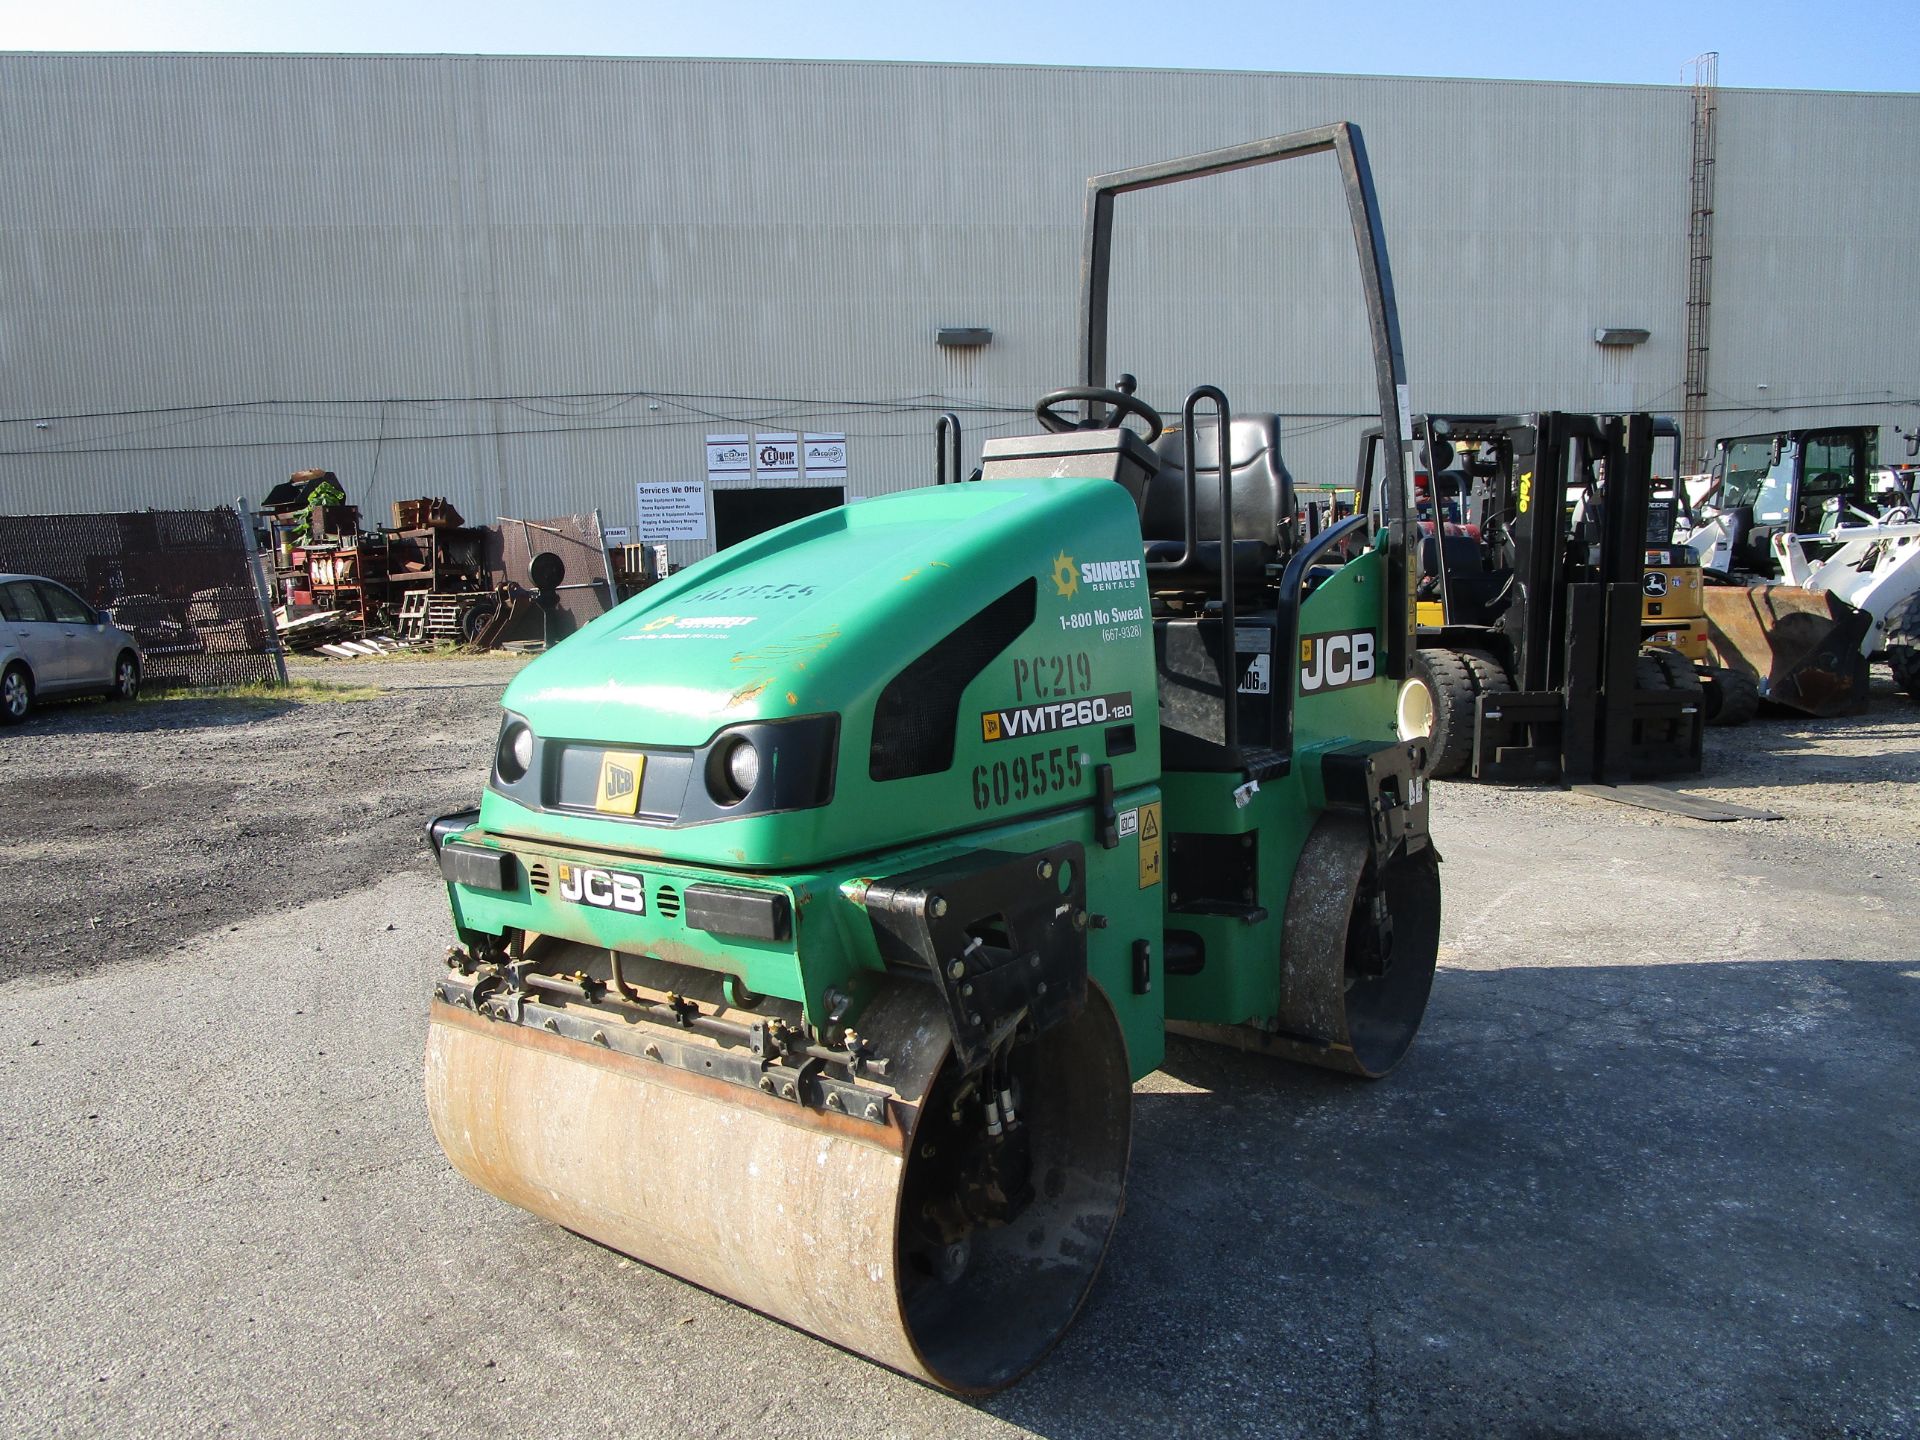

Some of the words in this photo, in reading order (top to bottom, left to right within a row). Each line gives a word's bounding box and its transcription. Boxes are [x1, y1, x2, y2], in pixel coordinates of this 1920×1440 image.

[768, 452, 794, 460] EQUIP
[1520, 472, 1532, 513] Yale
[1081, 560, 1140, 583] SUNBELT
[1092, 581, 1135, 591] RENTALS
[1060, 612, 1092, 630] 1-800
[1094, 610, 1109, 625] No
[1112, 606, 1143, 623] Sweat
[1102, 624, 1142, 642] (667-9328)
[1302, 632, 1374, 690] JCB
[1013, 652, 1091, 701] PC219
[608, 766, 632, 796] JCB
[972, 745, 1082, 810] 609555
[560, 868, 644, 912] JCB
